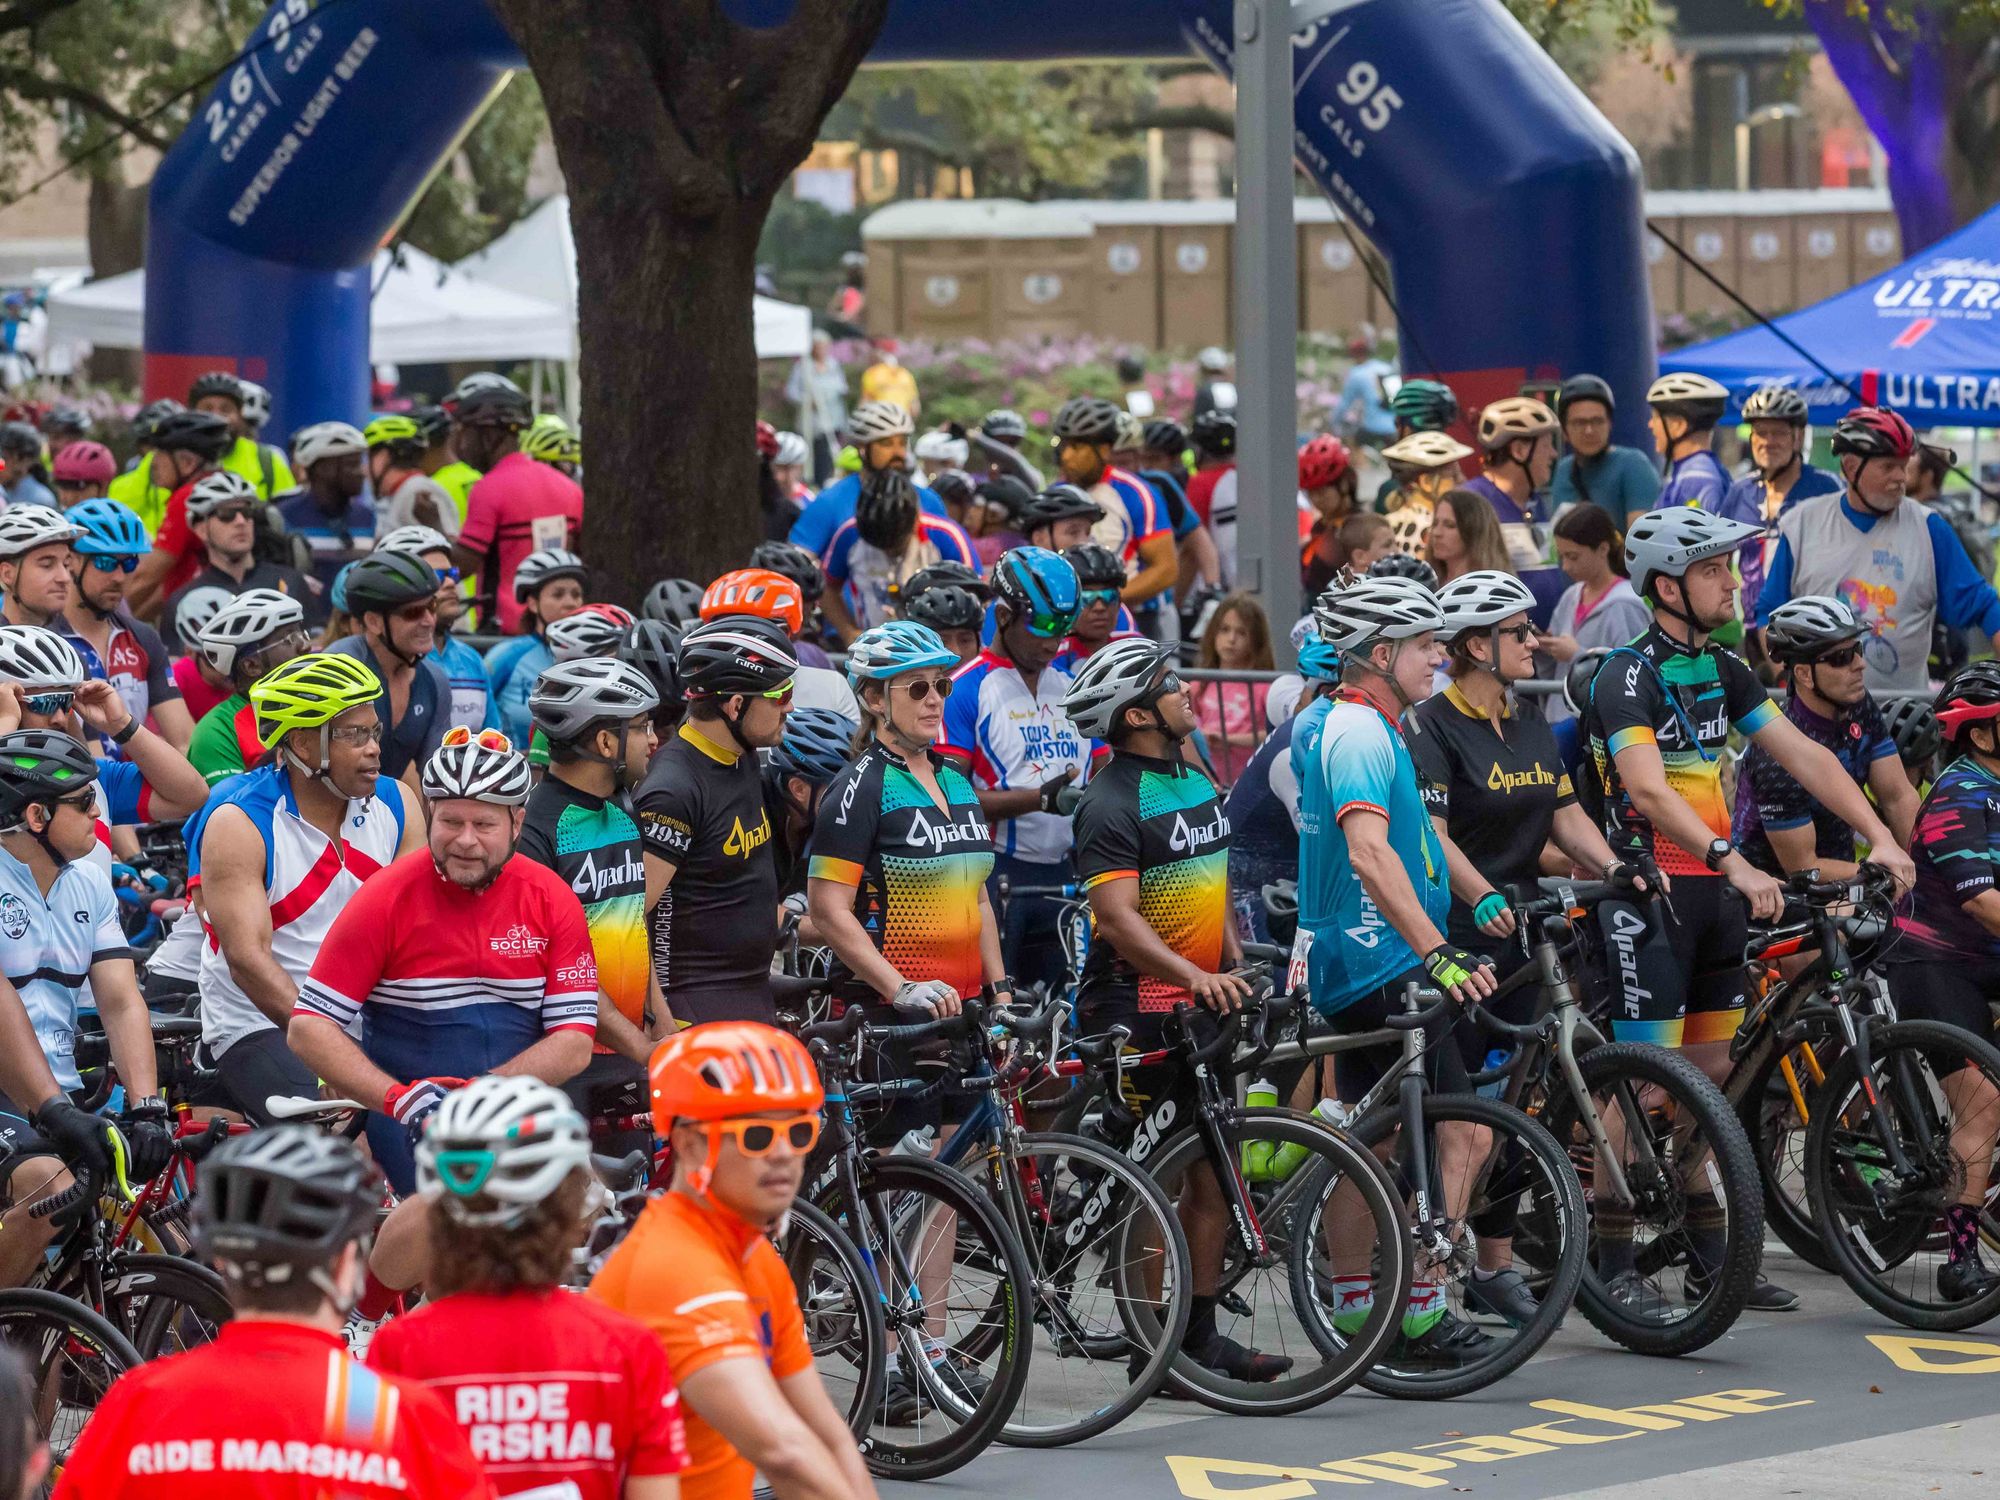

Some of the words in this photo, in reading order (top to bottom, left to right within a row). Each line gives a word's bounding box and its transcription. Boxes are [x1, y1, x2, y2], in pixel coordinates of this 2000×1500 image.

[285, 23, 323, 74] CALS
[205, 65, 252, 143] 2.6
[1336, 60, 1404, 131] 95
[228, 132, 301, 226] SUPERIOR
[294, 75, 341, 136] LIGHT
[335, 26, 379, 80] BEER
[1320, 104, 1365, 158] CALS
[1331, 172, 1375, 227] BEER
[610, 682, 645, 698] SCOTT
[1019, 725, 1052, 743] TOUR
[1056, 730, 1072, 740] de
[12, 767, 40, 781] SMITH
[1487, 761, 1557, 795] Apache
[723, 806, 772, 860] Apach
[1169, 805, 1231, 855] Apach
[572, 848, 645, 900] Apache
[490, 939, 549, 951] SOCIETY
[1610, 909, 1653, 1020] Apache
[556, 969, 598, 981] SOCIET
[1064, 1099, 1177, 1247] cerélo
[455, 1381, 570, 1425] RIDE
[128, 1439, 215, 1475] RIDE
[221, 1438, 408, 1490] MARSHAL
[470, 1420, 616, 1462] RSHAL
[1164, 1388, 1816, 1500] Apache
